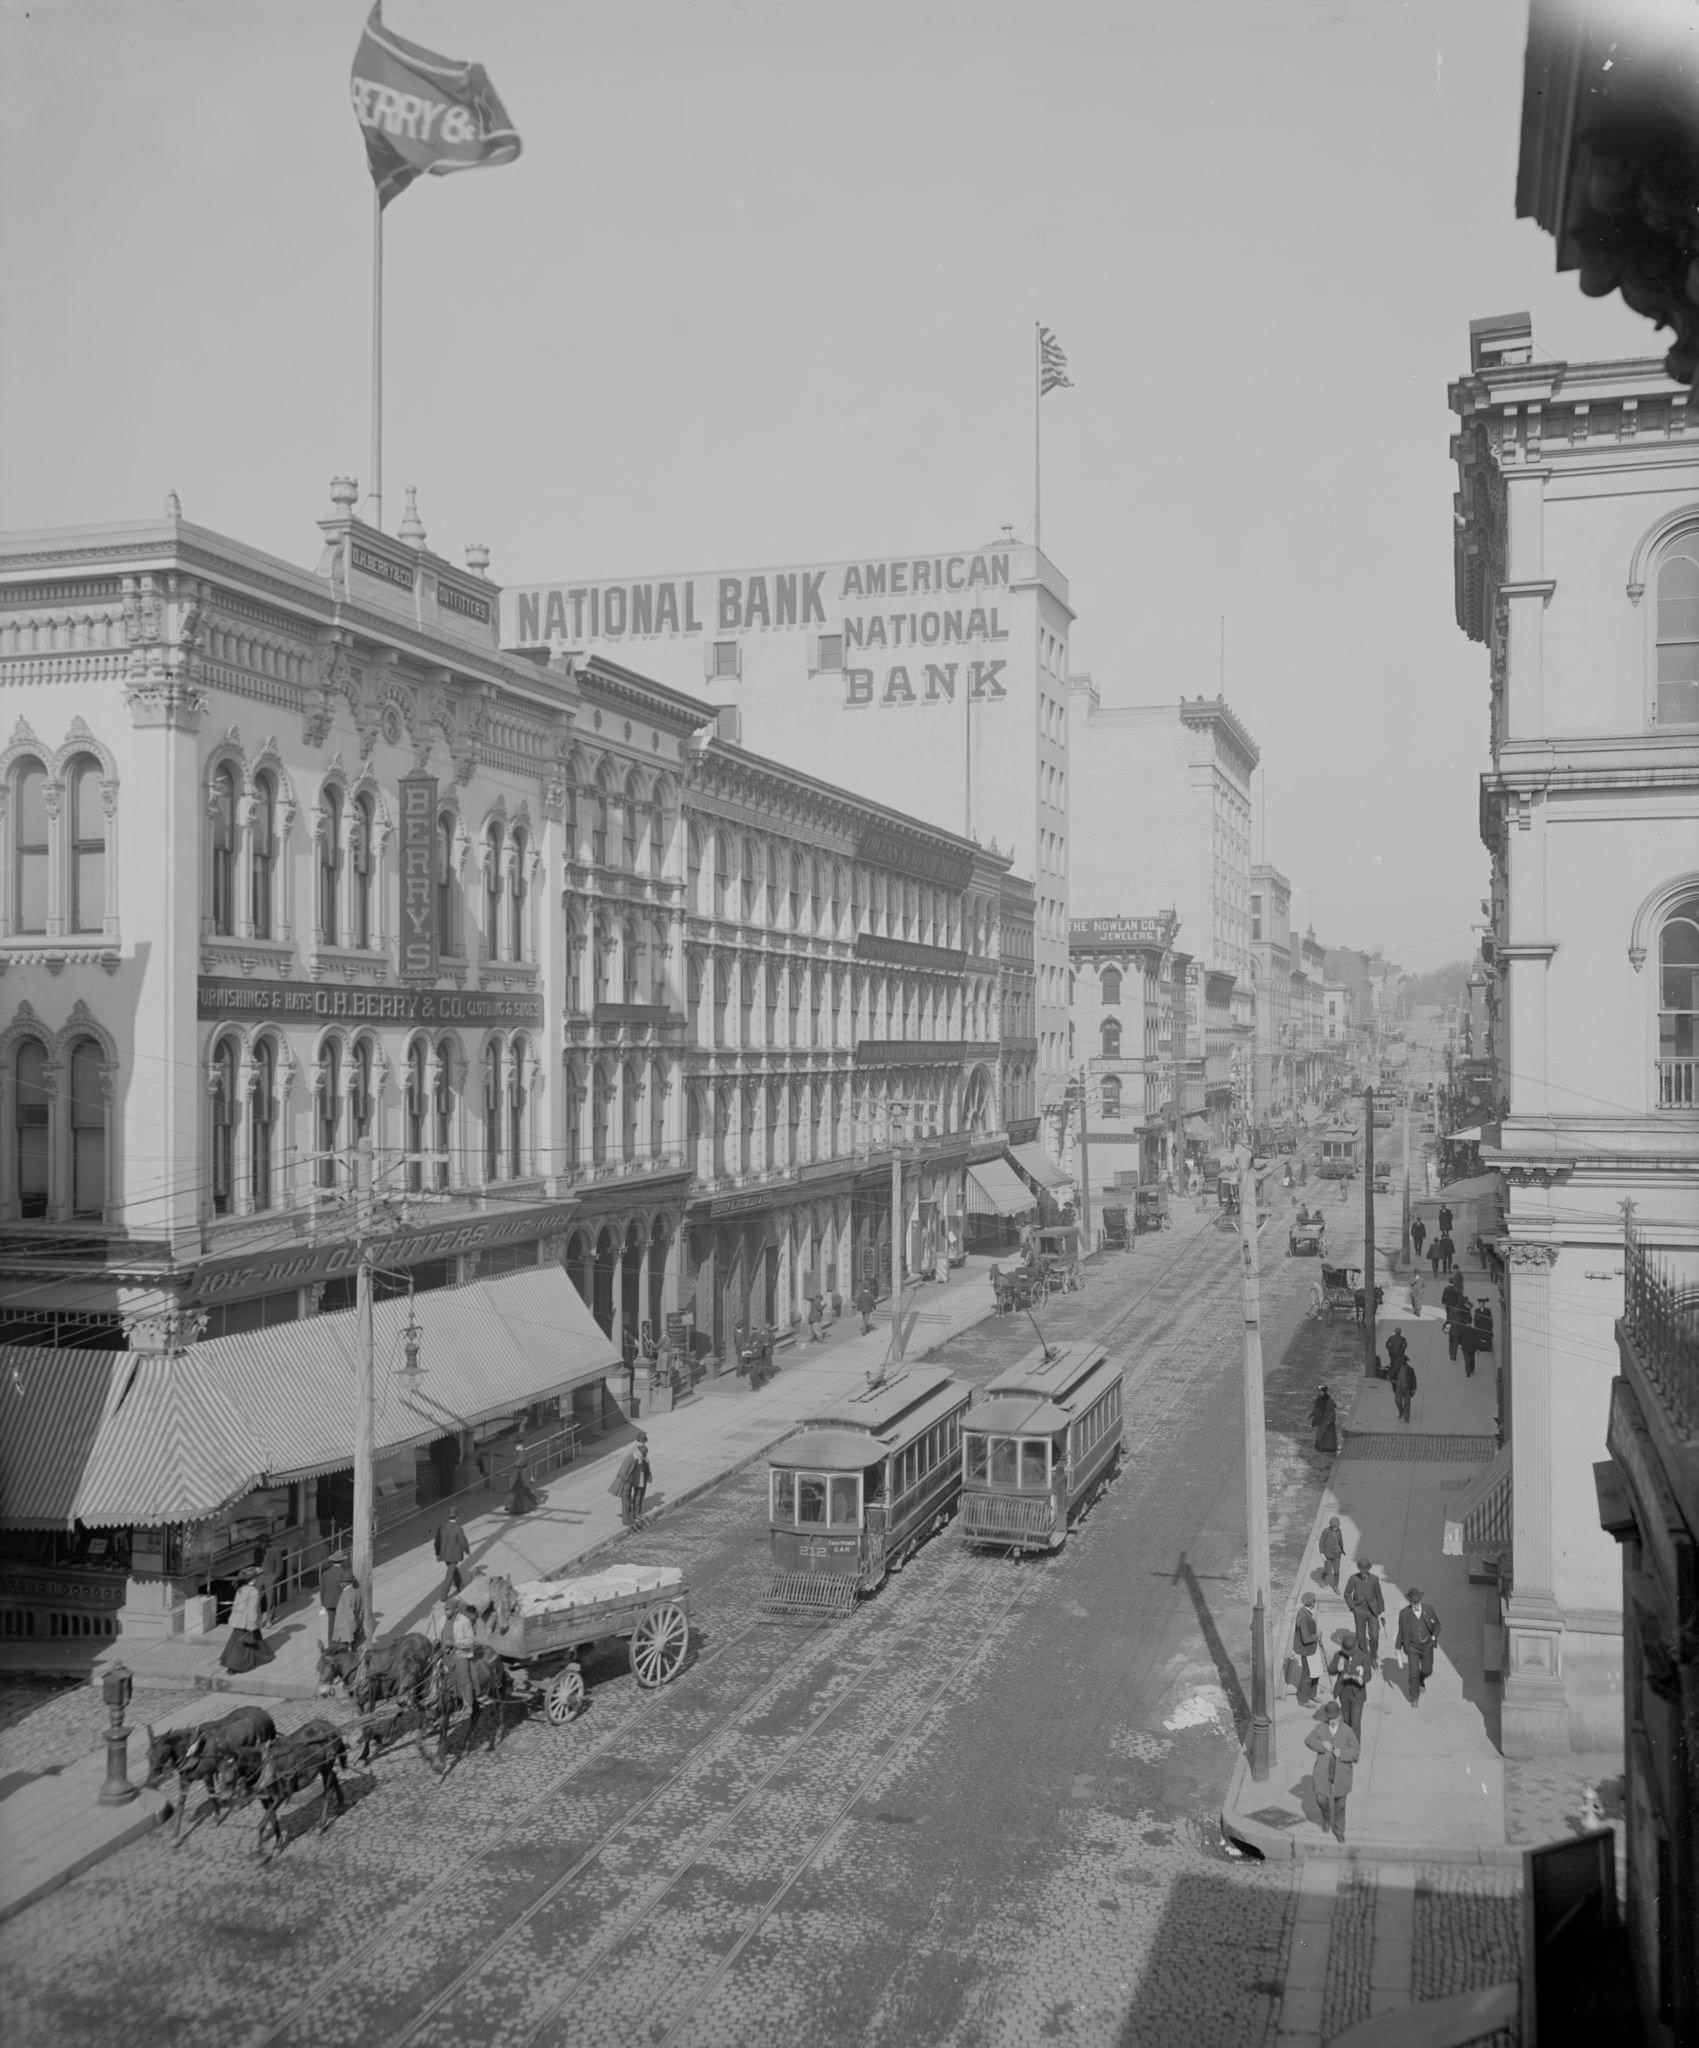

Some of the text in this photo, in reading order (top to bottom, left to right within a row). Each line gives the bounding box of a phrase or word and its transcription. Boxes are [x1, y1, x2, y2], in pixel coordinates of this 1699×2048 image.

[441, 105, 475, 144] &
[842, 554, 1010, 597] AMERICAN
[518, 571, 827, 643] NATIONAL BANK
[844, 607, 1010, 648] NATIONAL
[845, 660, 1008, 706] BANK
[405, 787, 432, 970] BERRY'S
[1068, 921, 1088, 932] THE
[1094, 920, 1137, 931] NOWLAN
[272, 991, 280, 1008] &
[284, 992, 313, 1010] HATS
[422, 996, 435, 1017] &
[799, 1545, 827, 1558] 212
